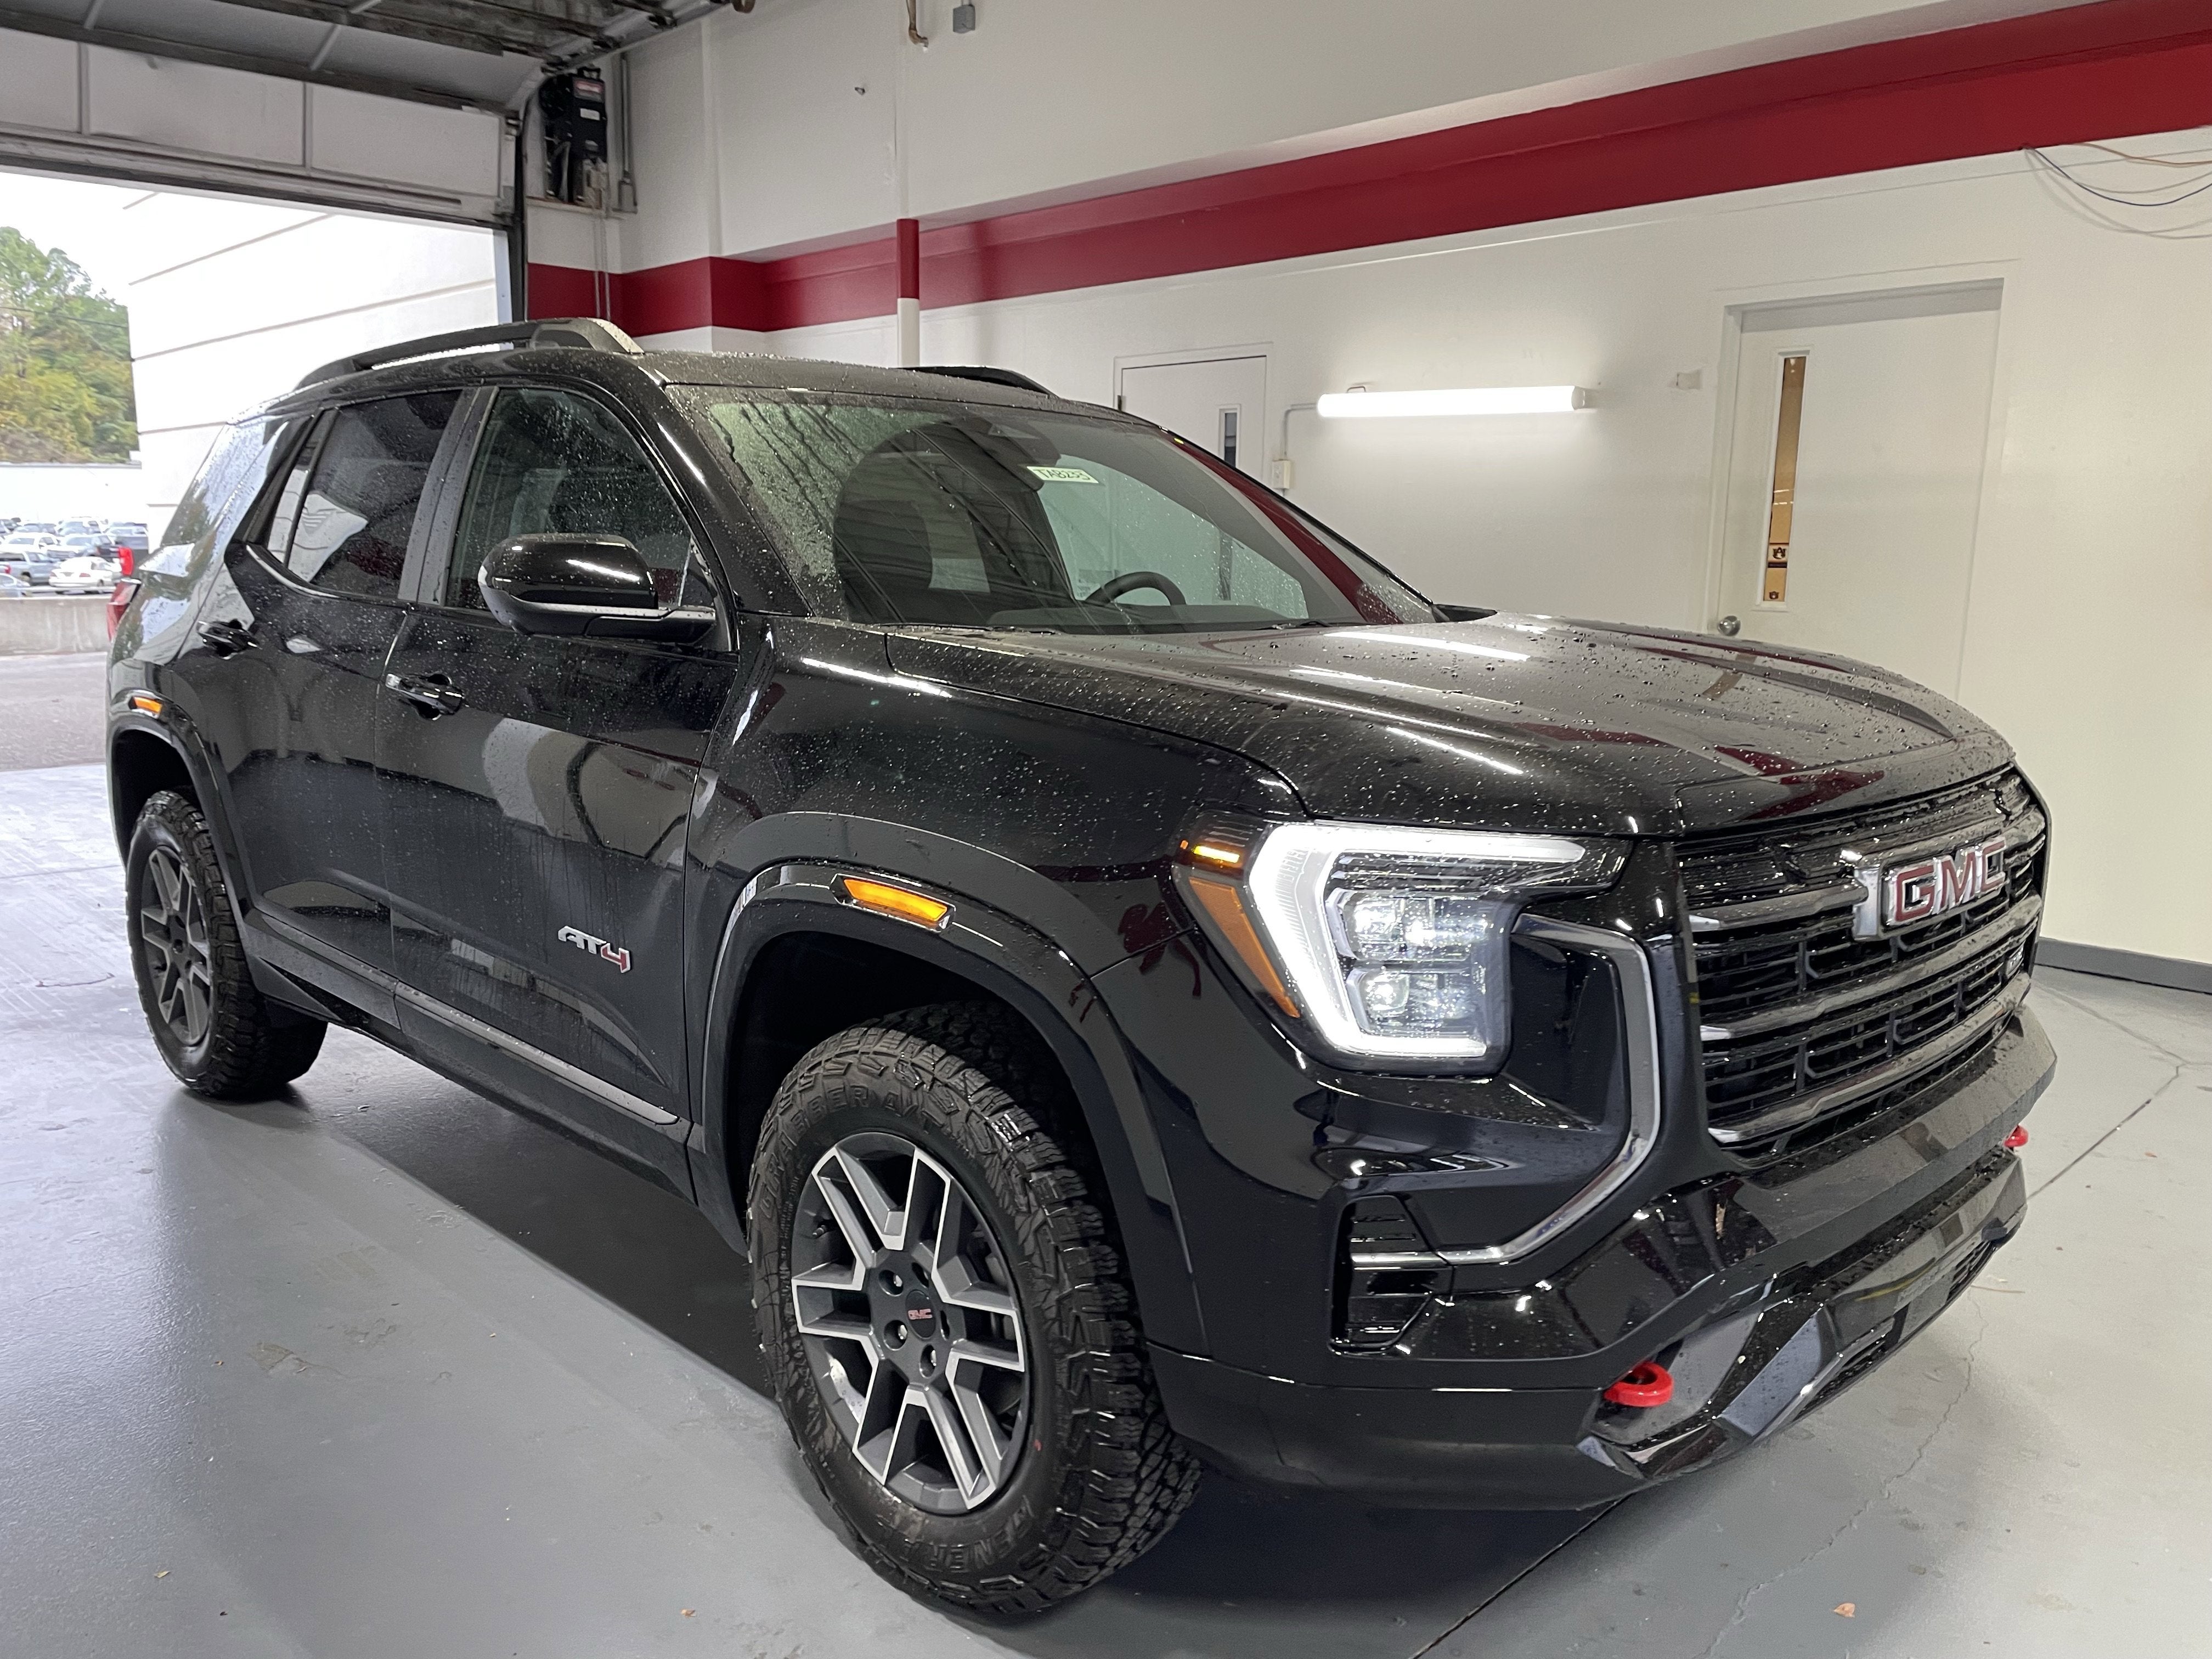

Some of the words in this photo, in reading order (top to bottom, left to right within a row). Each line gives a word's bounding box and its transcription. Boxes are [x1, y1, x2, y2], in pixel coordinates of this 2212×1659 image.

[1888, 836, 2008, 926] GMC
[558, 926, 630, 973] AT4
[759, 1084, 869, 1219] GRABBER
[908, 1308, 933, 1320] GMC
